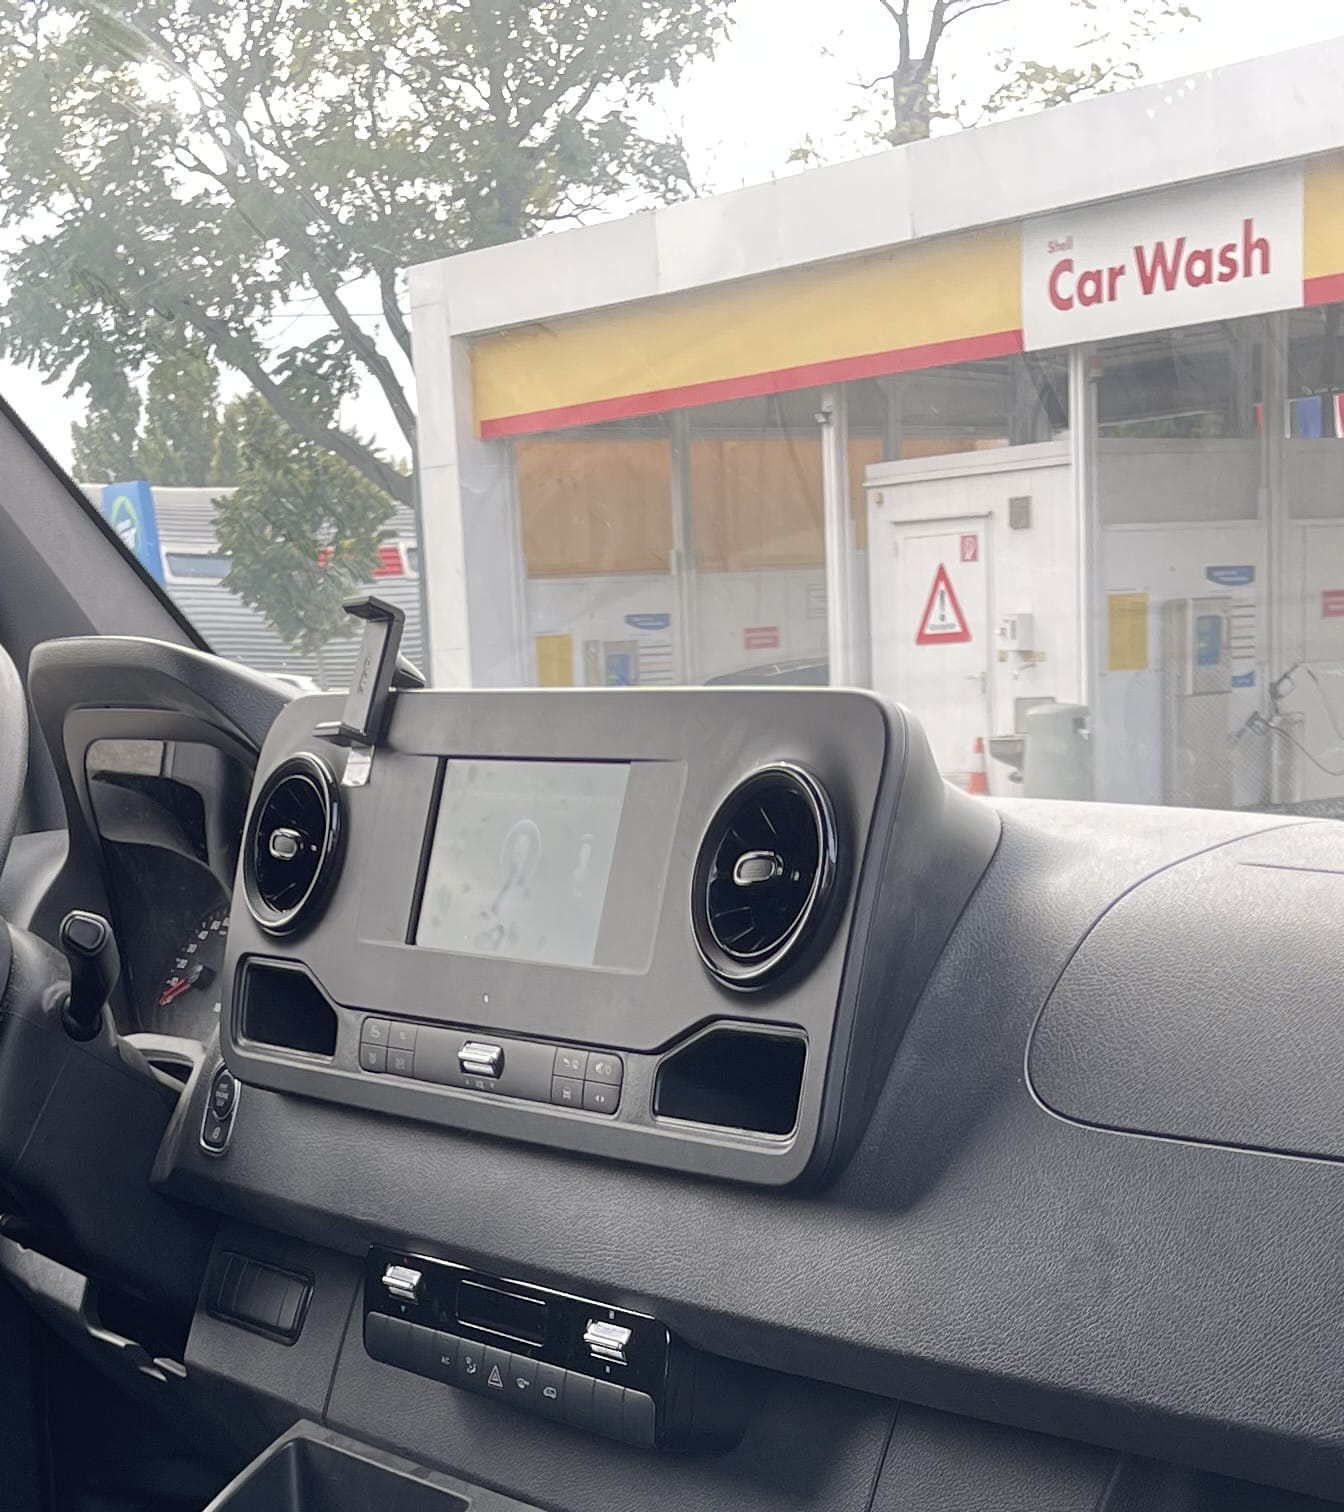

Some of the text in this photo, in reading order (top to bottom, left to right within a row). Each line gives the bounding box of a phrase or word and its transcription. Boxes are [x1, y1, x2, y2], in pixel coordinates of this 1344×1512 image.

[1047, 235, 1074, 253] Shell
[1048, 218, 1271, 311] Car Wash
